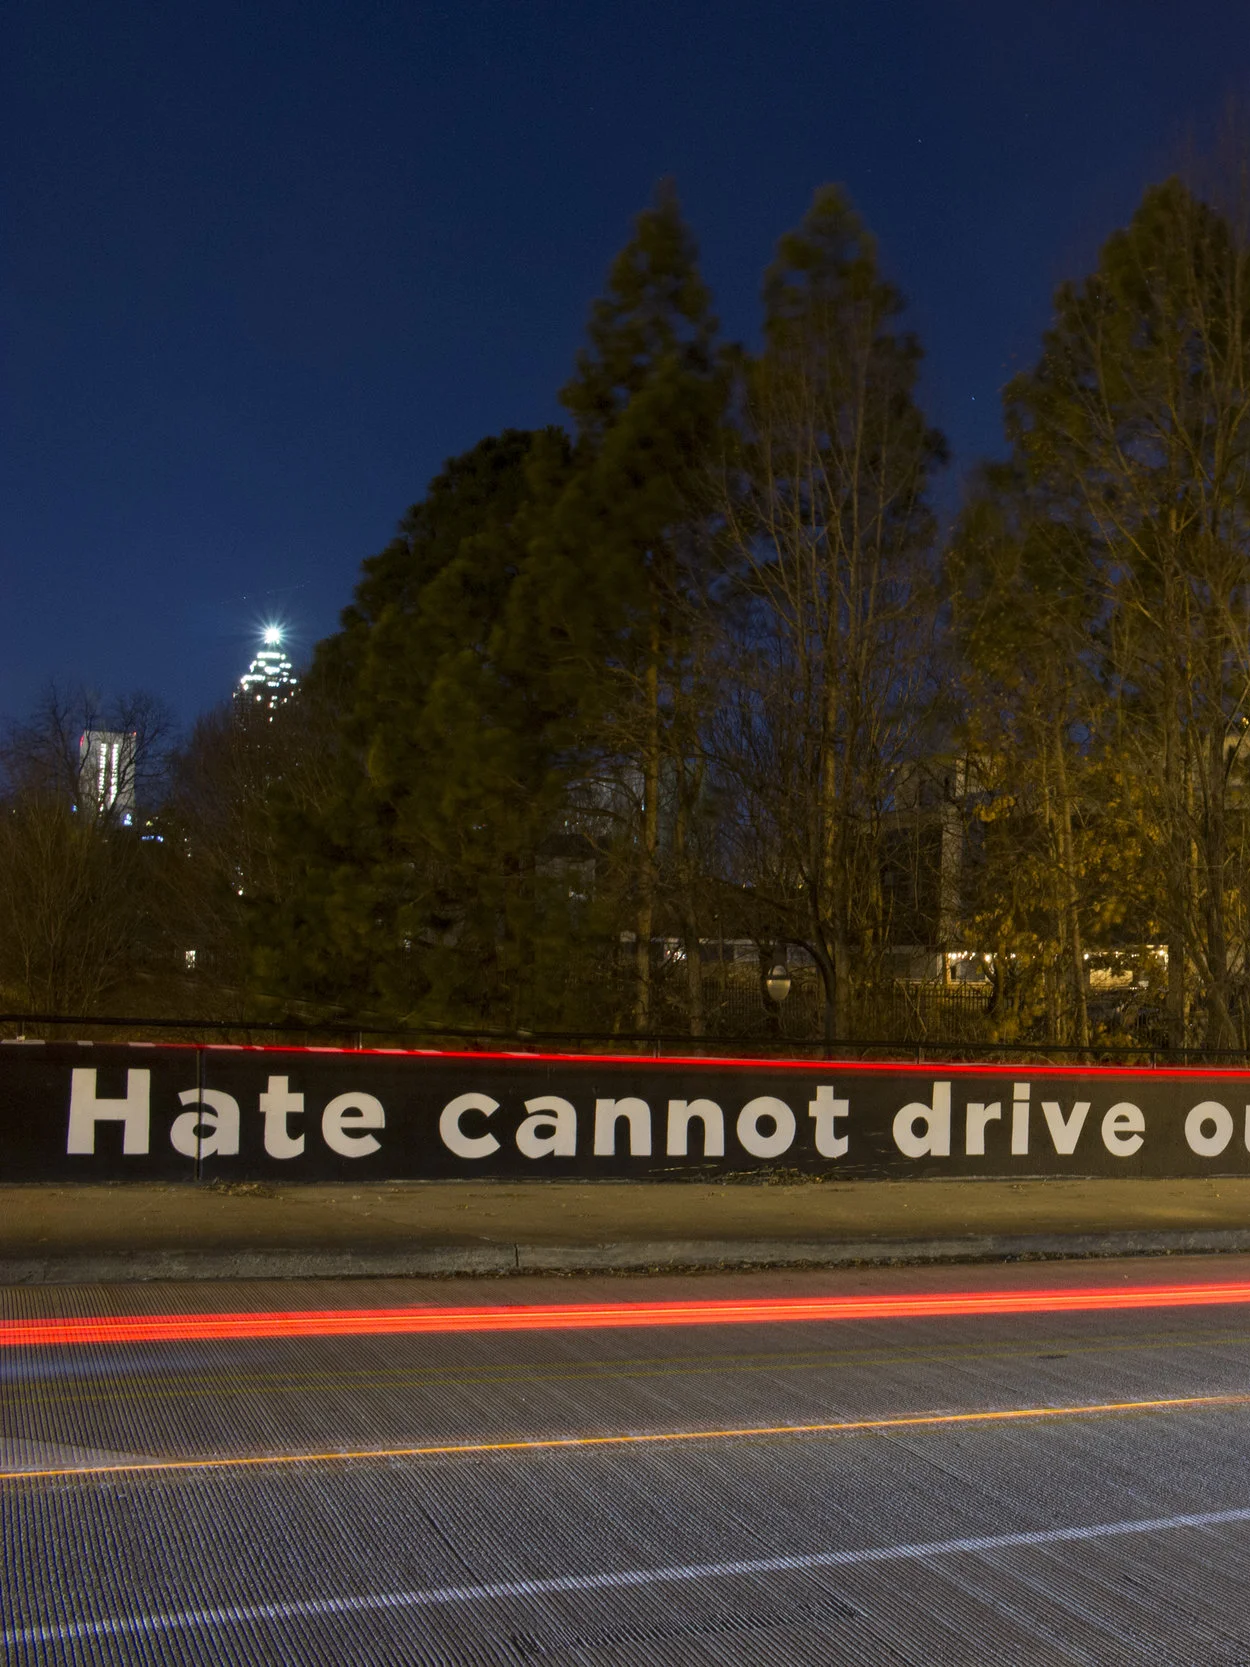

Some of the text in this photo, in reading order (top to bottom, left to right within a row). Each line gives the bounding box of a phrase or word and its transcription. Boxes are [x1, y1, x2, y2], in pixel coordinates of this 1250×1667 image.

[68, 1069, 386, 1159] Hate
[440, 1086, 850, 1158] cannot
[893, 1082, 1146, 1157] drive
